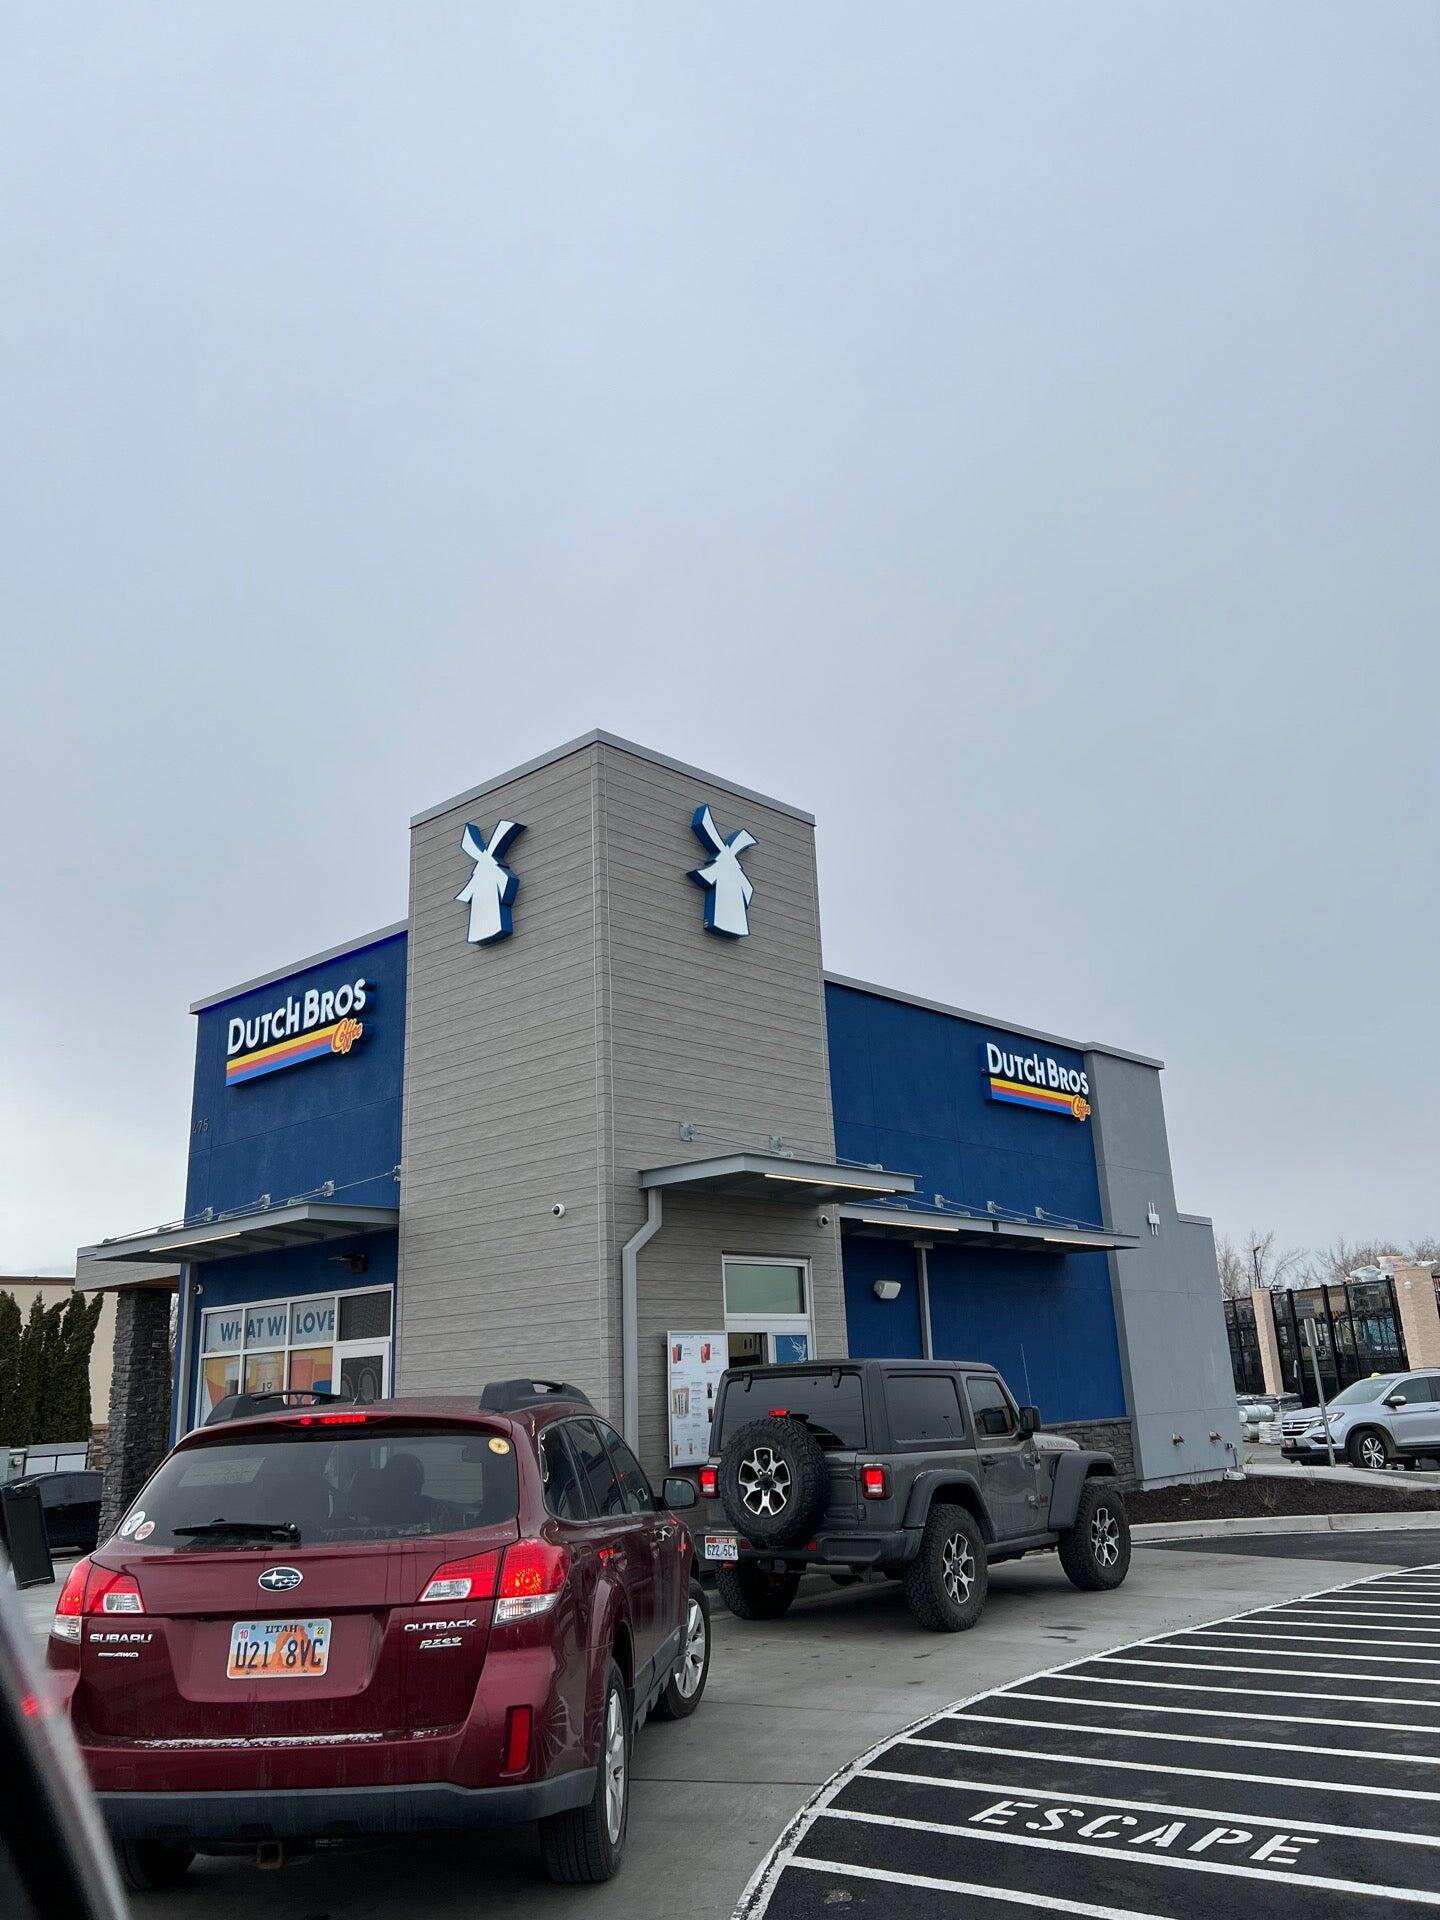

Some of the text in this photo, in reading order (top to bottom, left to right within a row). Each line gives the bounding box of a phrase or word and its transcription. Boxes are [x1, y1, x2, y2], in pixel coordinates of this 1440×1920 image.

[227, 978, 366, 1056] DUTCH BROS
[986, 1042, 1089, 1096] DUTCH BROS
[296, 1309, 335, 1335] LOVE
[89, 1633, 153, 1644] SUBARU
[264, 1624, 299, 1634] UTAH
[403, 1619, 478, 1632] OUTBACK
[235, 1638, 324, 1668] U21 8VC
[967, 1800, 1320, 1865] ESCAPE
